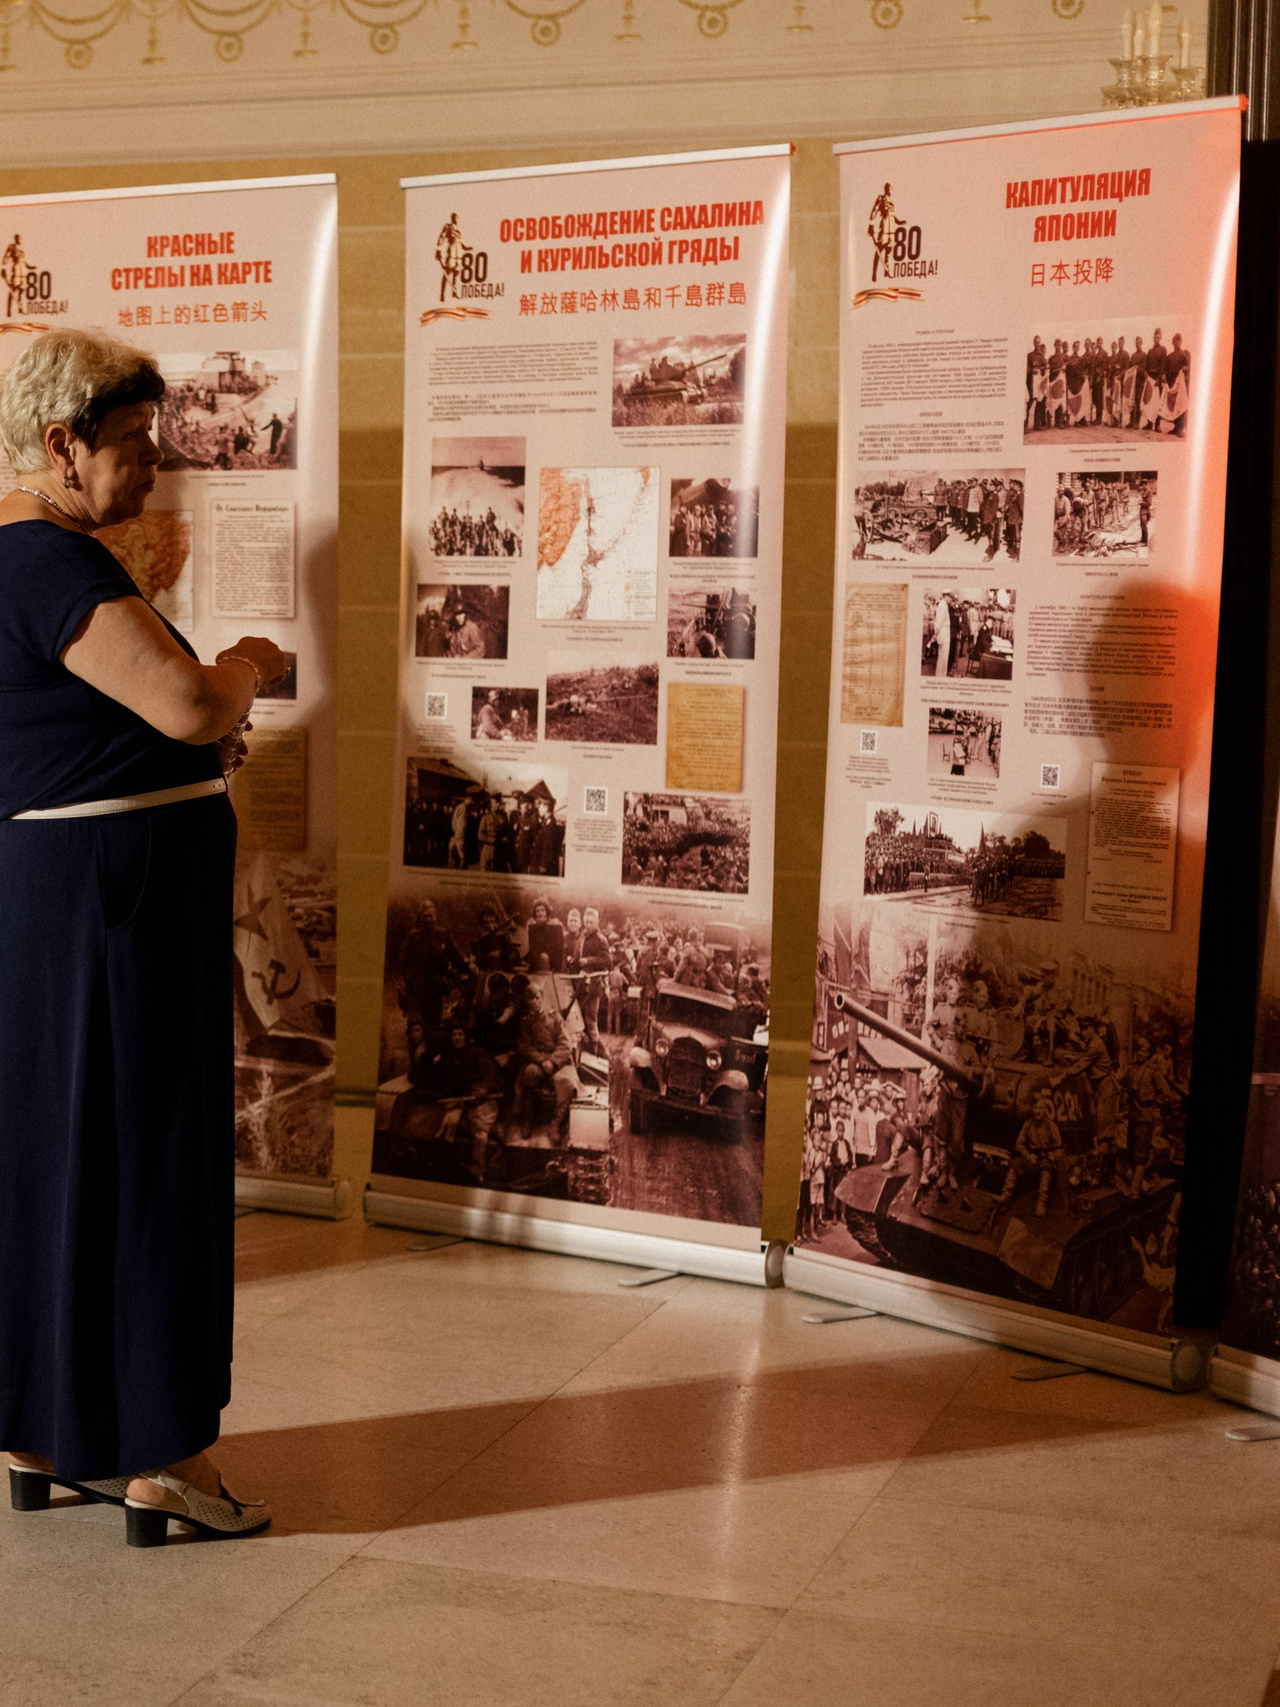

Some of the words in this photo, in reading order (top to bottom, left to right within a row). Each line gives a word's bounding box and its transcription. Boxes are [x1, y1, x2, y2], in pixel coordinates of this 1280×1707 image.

[1005, 168, 1152, 208] КАПИТУЛЯЦИЯ
[499, 208, 656, 243] ОСВОБОЖДЕНИЕ
[660, 200, 765, 233] САХАЛИНА
[1033, 209, 1117, 243] ЯПОНИИ
[147, 231, 235, 258] КРАСНЫЕ
[520, 250, 532, 274] И
[536, 237, 663, 273] КУРИЛЬСКОЙ
[667, 236, 740, 267] ГРЯДЫ
[893, 226, 922, 261] 80
[111, 264, 186, 291] СТРЕЛЫ
[190, 263, 213, 287] НА
[217, 260, 273, 285] КАРТЕ
[461, 252, 488, 284] 80
[893, 260, 938, 278] ПОБЕДА!
[1031, 257, 1115, 288] 日本投降
[26, 271, 52, 300] 80
[460, 283, 505, 300] ПОБЕДА!
[26, 300, 69, 316] ПОБЕДА!
[118, 301, 268, 327] 地图上的红色箭头
